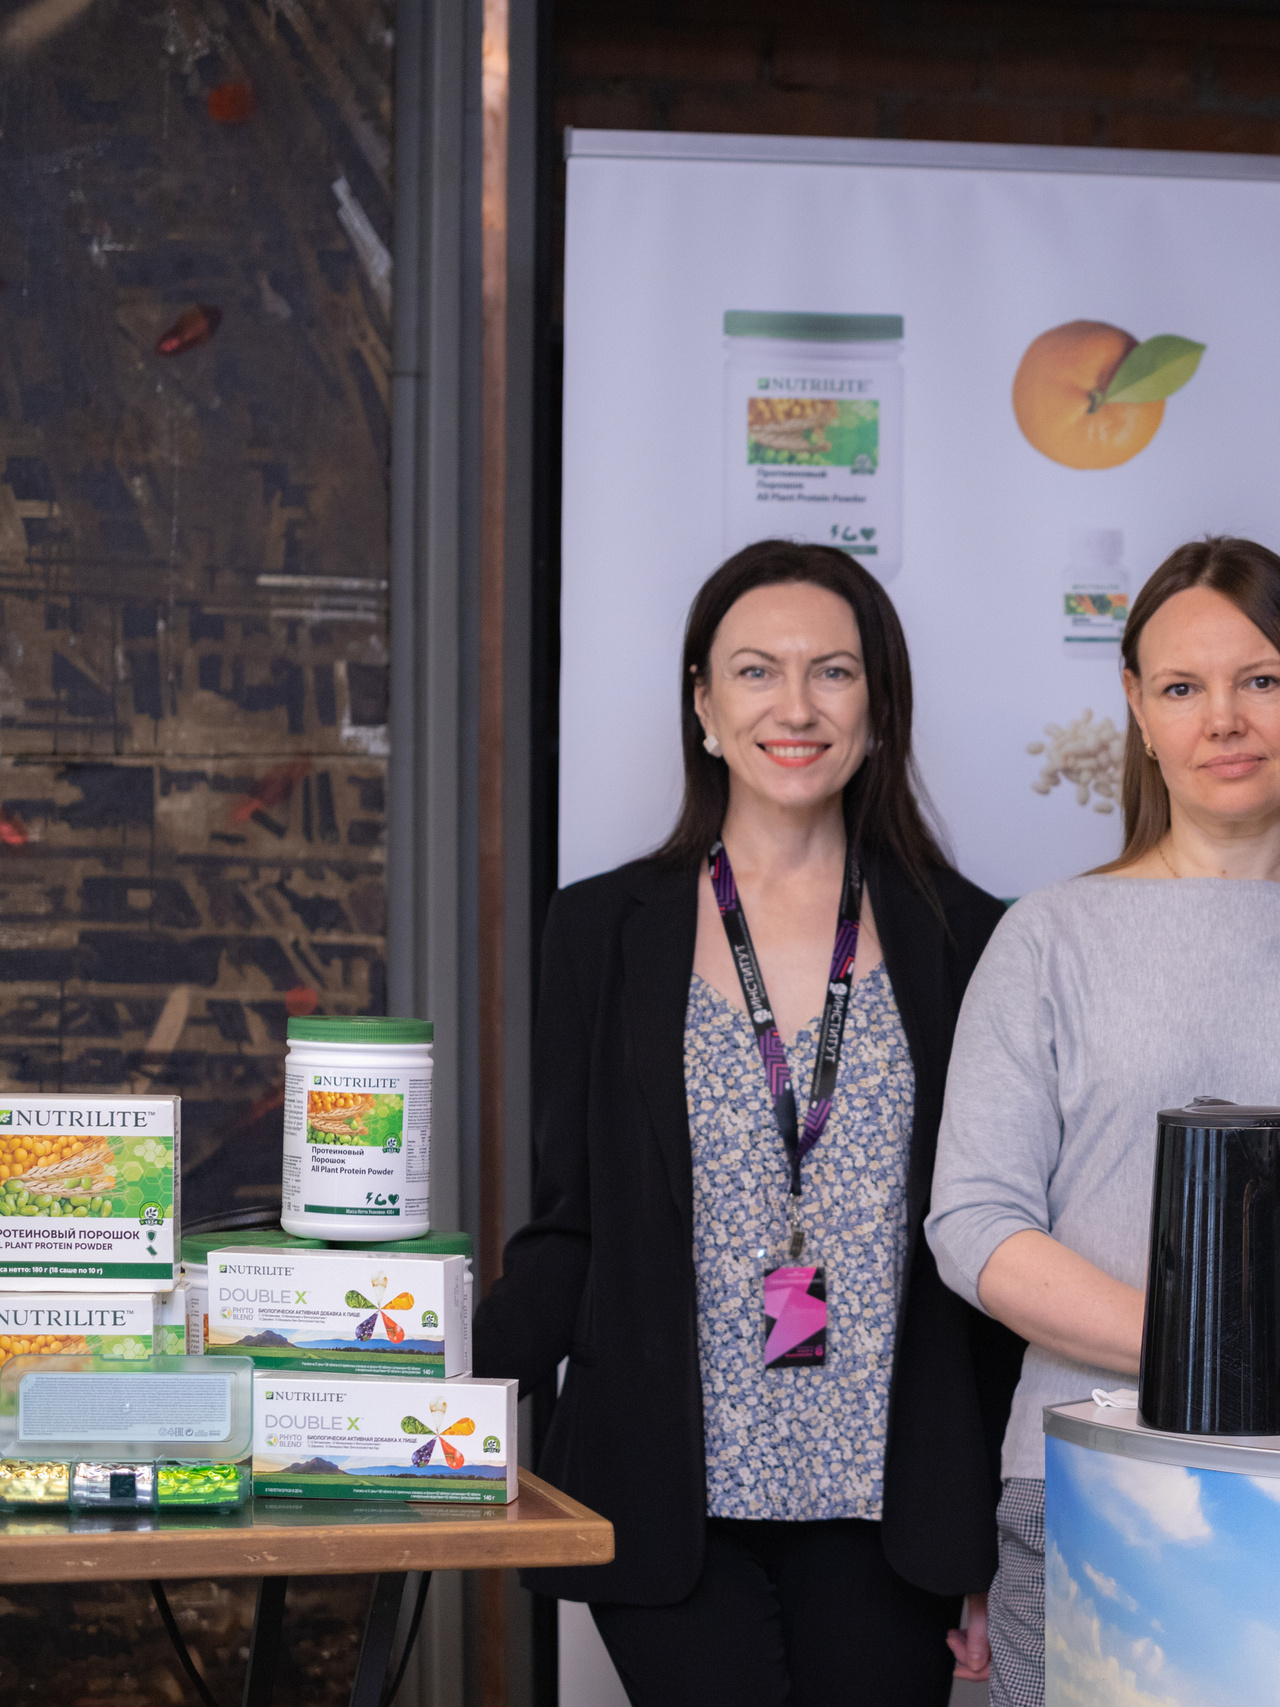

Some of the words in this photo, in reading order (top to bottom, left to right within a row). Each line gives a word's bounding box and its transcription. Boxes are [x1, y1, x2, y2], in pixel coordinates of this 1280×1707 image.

[734, 944, 763, 1010] ИНСТИТУТ
[824, 995, 845, 1063] ИНСТИТУТ
[311, 1146, 364, 1156] Протеиновый
[311, 1155, 346, 1165] Порошок
[311, 1165, 320, 1173] All
[320, 1166, 338, 1174] Plant
[339, 1167, 366, 1175] Protein
[367, 1168, 394, 1176] Powder
[78, 1230, 140, 1240] ПОРОШОК
[35, 1242, 73, 1250] PROTEIN
[74, 1242, 113, 1251] POWDER
[49, 1266, 58, 1274] (18
[219, 1287, 291, 1304] DOUBLE
[295, 1290, 307, 1304] X
[232, 1313, 254, 1321] BLEND
[265, 1414, 343, 1431] DOUBLE
[346, 1416, 360, 1431] X
